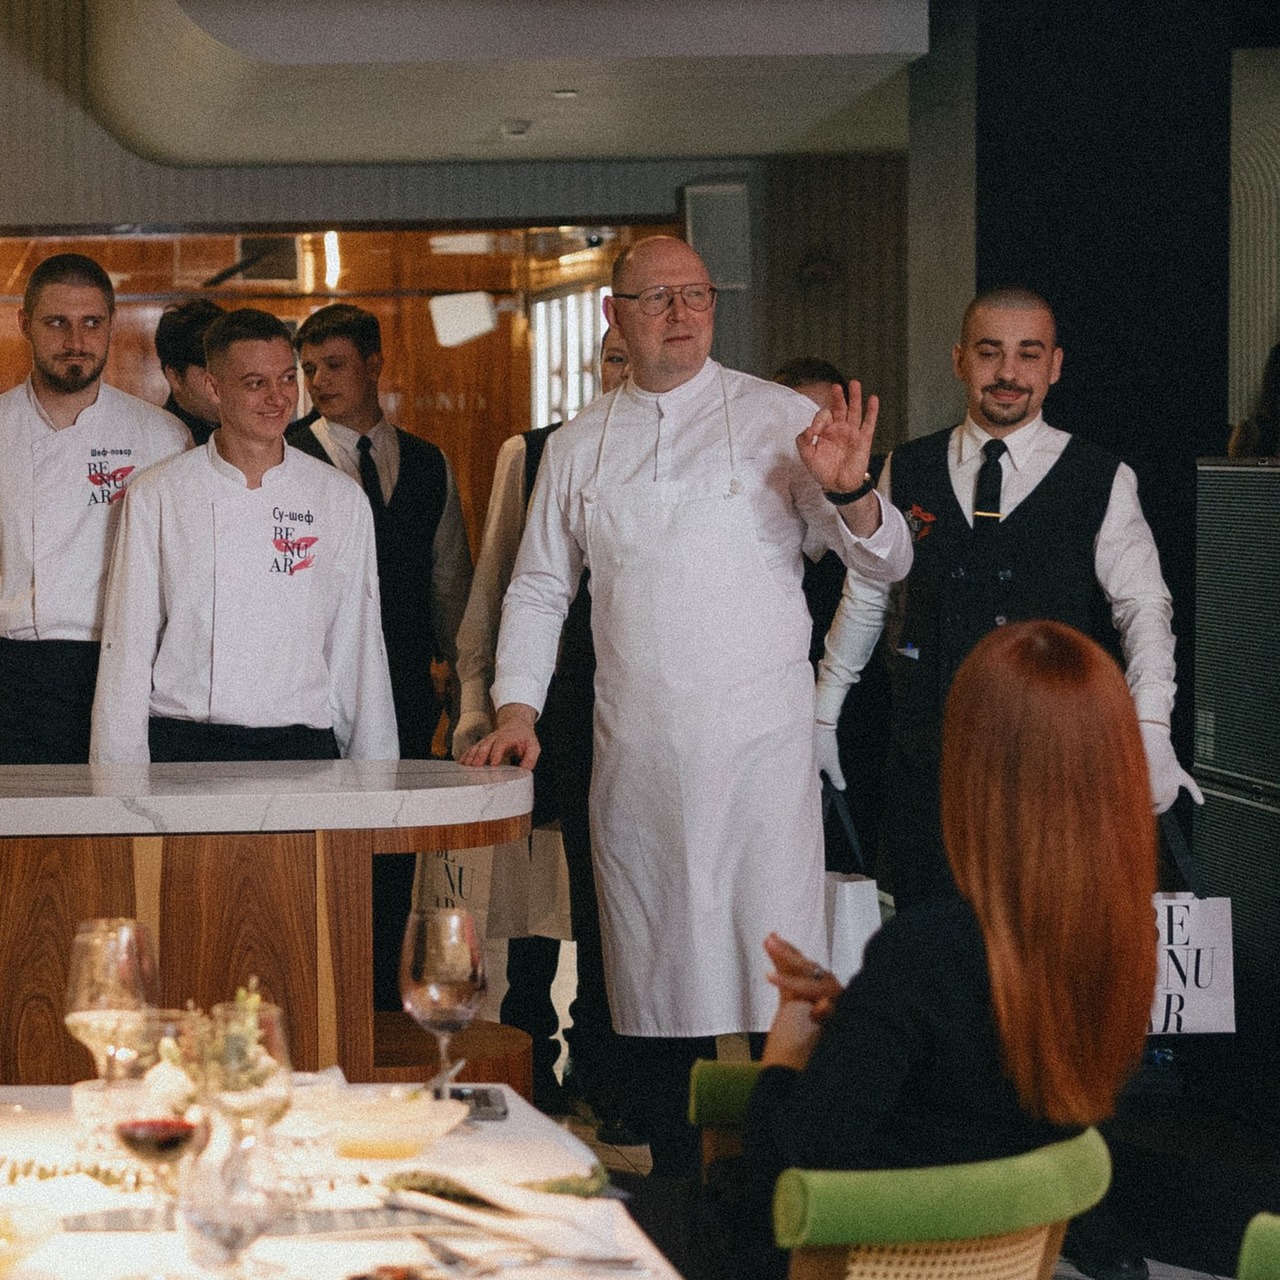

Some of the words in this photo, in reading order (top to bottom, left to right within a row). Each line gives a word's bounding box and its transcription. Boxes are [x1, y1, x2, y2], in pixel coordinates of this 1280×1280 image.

[91, 448, 131, 457] Шеф-повар
[87, 461, 110, 476] BE
[99, 475, 124, 489] NU
[87, 489, 111, 506] AR
[272, 507, 314, 525] Су-шеф
[273, 526, 295, 542] BE
[283, 542, 308, 559] NU
[269, 558, 294, 573] AR
[1163, 947, 1217, 990] NU
[1147, 993, 1186, 1033] R
